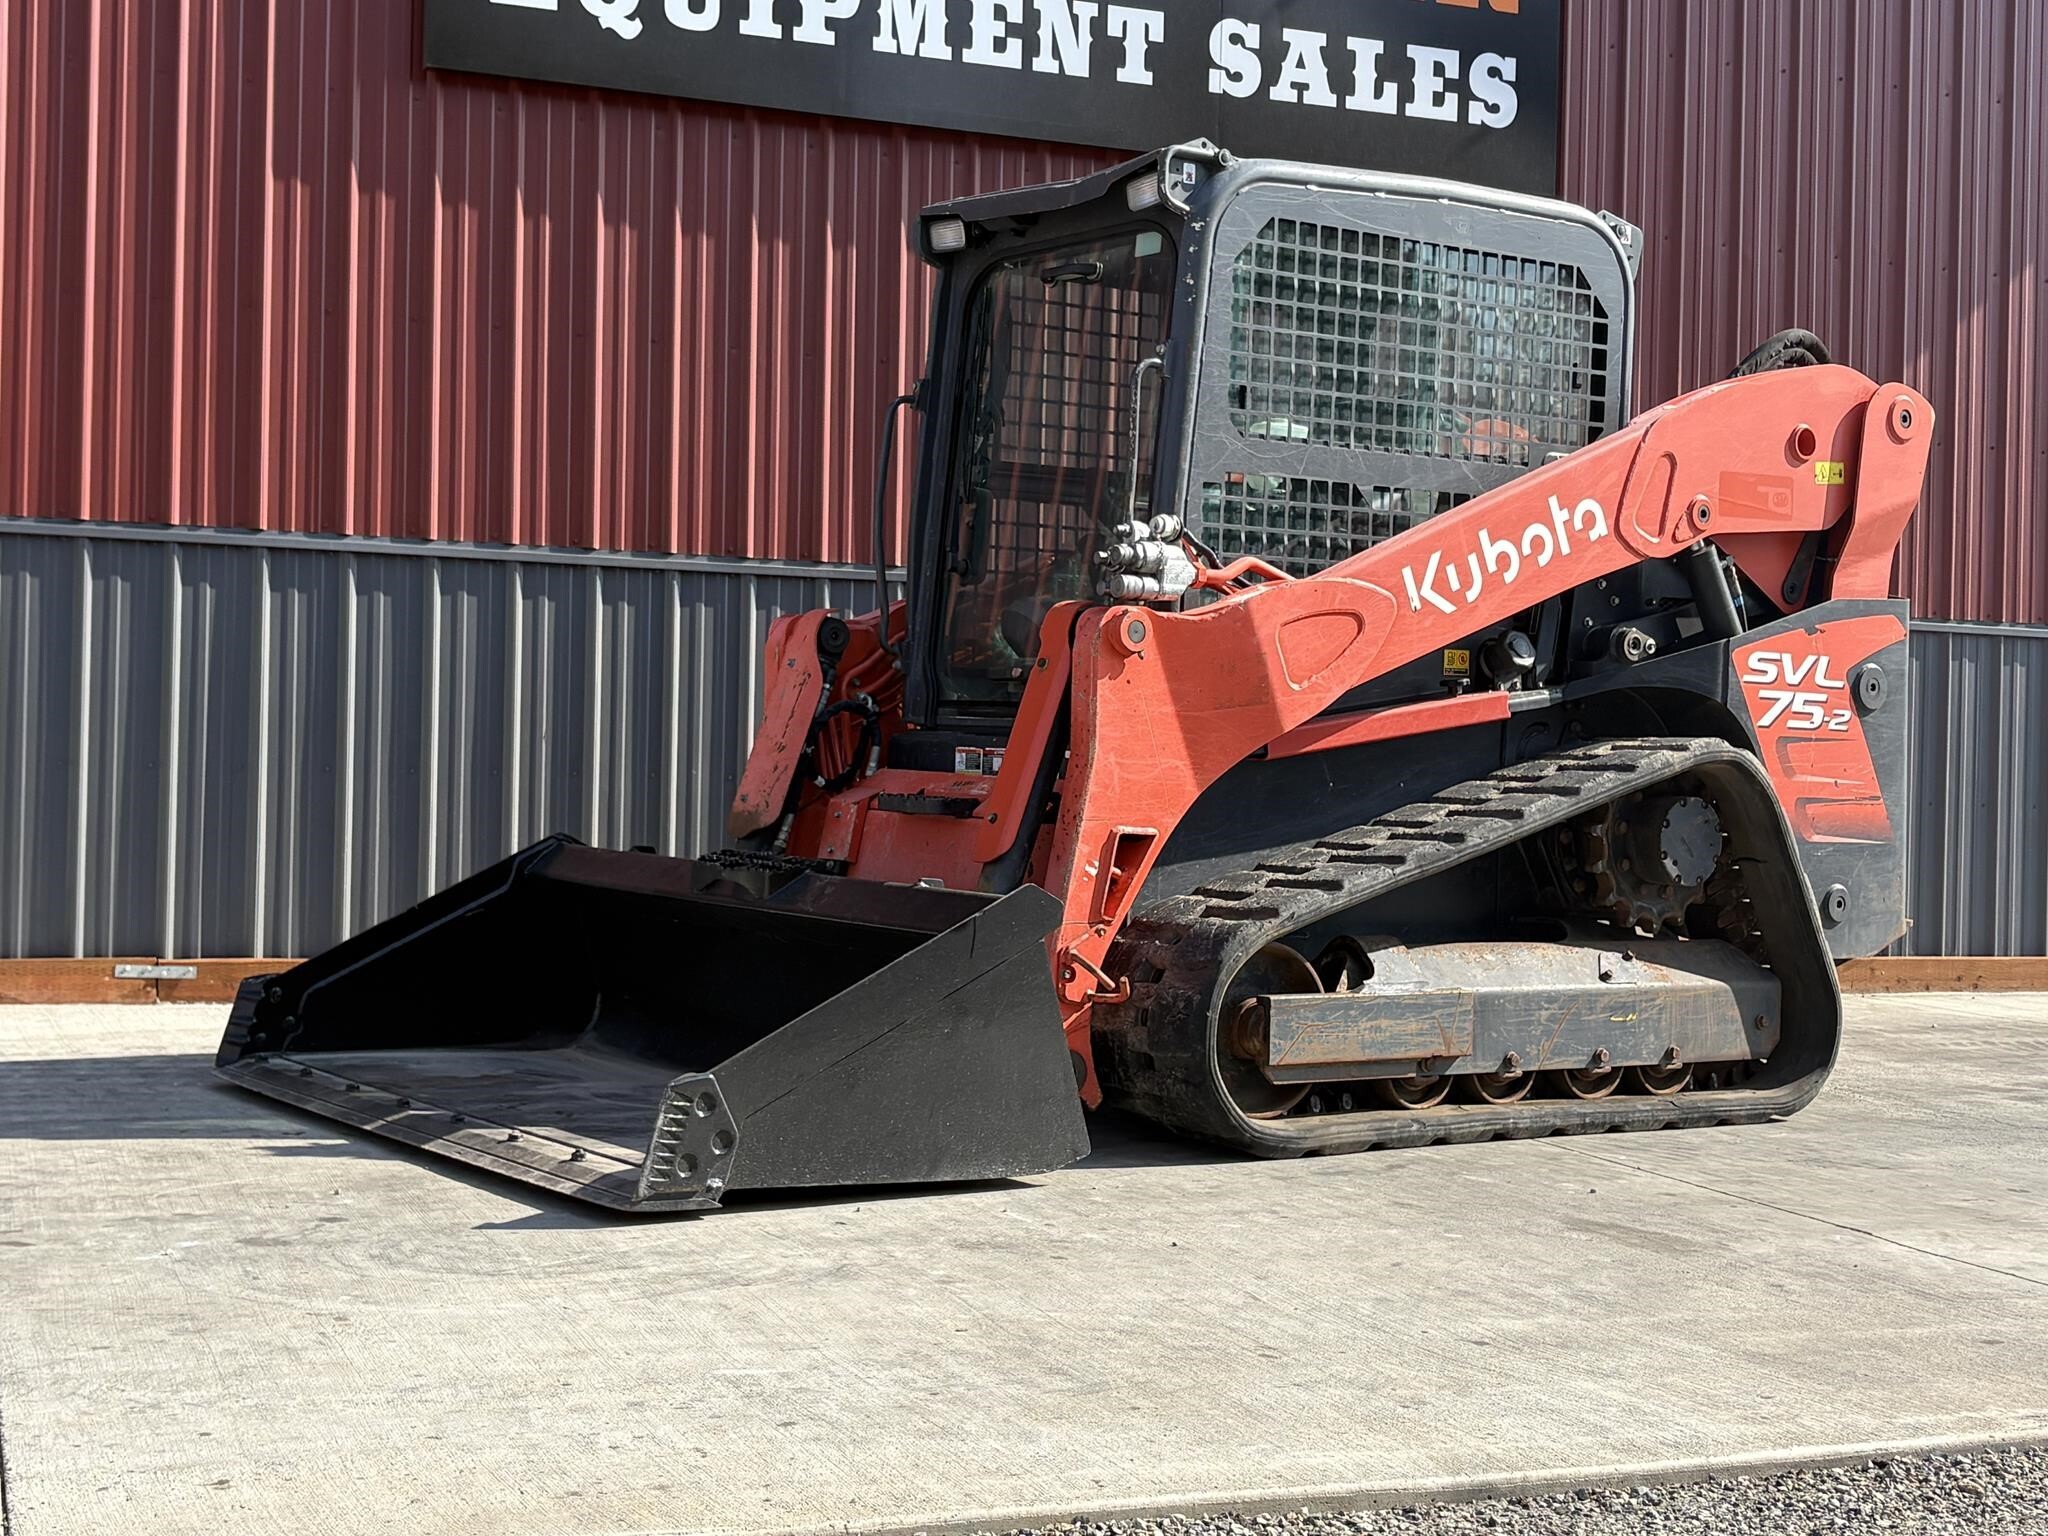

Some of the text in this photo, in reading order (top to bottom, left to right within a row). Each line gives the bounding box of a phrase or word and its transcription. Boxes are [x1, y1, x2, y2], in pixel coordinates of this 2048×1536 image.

[1208, 18, 1518, 129] SALES
[1401, 495, 1609, 614] Kubota
[1739, 650, 1845, 688] SVL
[1756, 689, 1853, 731] 75-2
